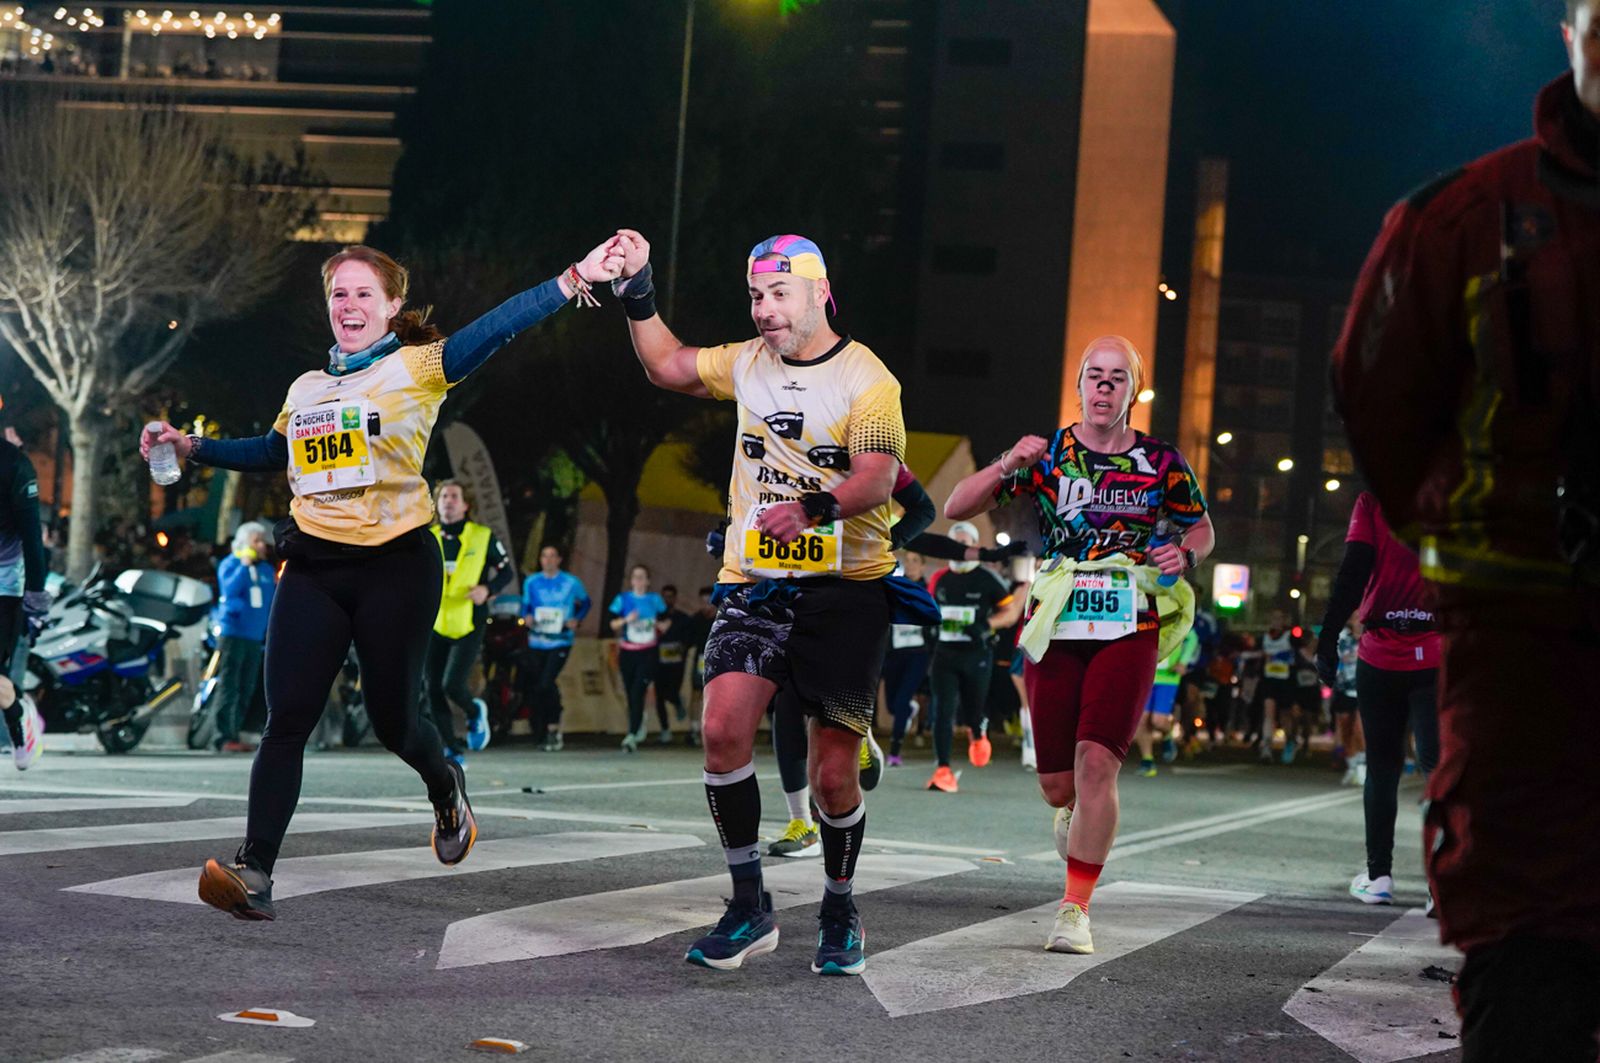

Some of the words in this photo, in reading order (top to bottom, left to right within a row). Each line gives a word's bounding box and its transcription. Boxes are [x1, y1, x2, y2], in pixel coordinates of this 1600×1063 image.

[302, 414, 325, 426] NOCHE
[325, 412, 335, 422] DE
[296, 428, 311, 439] SAN
[304, 432, 354, 464] 5164
[757, 466, 822, 492] BALAS
[1091, 488, 1149, 507] HUELVA
[758, 533, 824, 562] 5836
